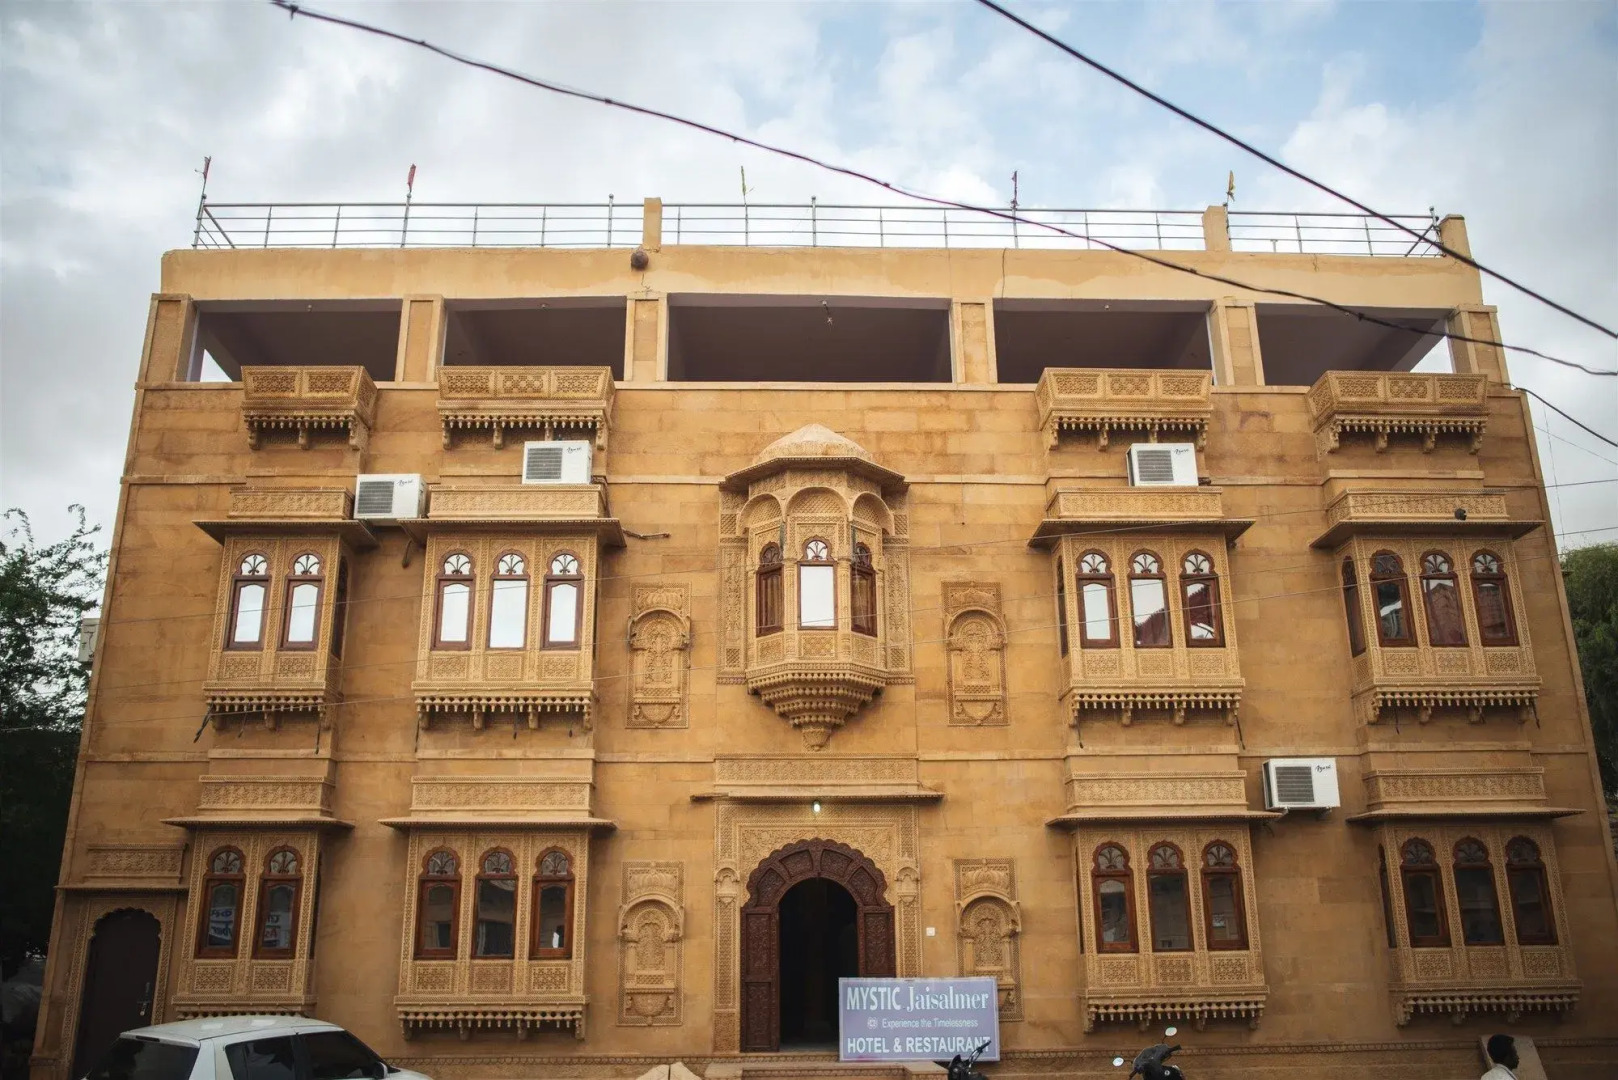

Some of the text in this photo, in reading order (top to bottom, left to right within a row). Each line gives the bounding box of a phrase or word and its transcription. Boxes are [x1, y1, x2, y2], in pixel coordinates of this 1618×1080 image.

[846, 986, 989, 1012] MYSTIC Jaisalmer
[882, 1017, 979, 1029] Experience the Timelessness
[847, 1036, 991, 1053] HOTEL & RESTAURANT
